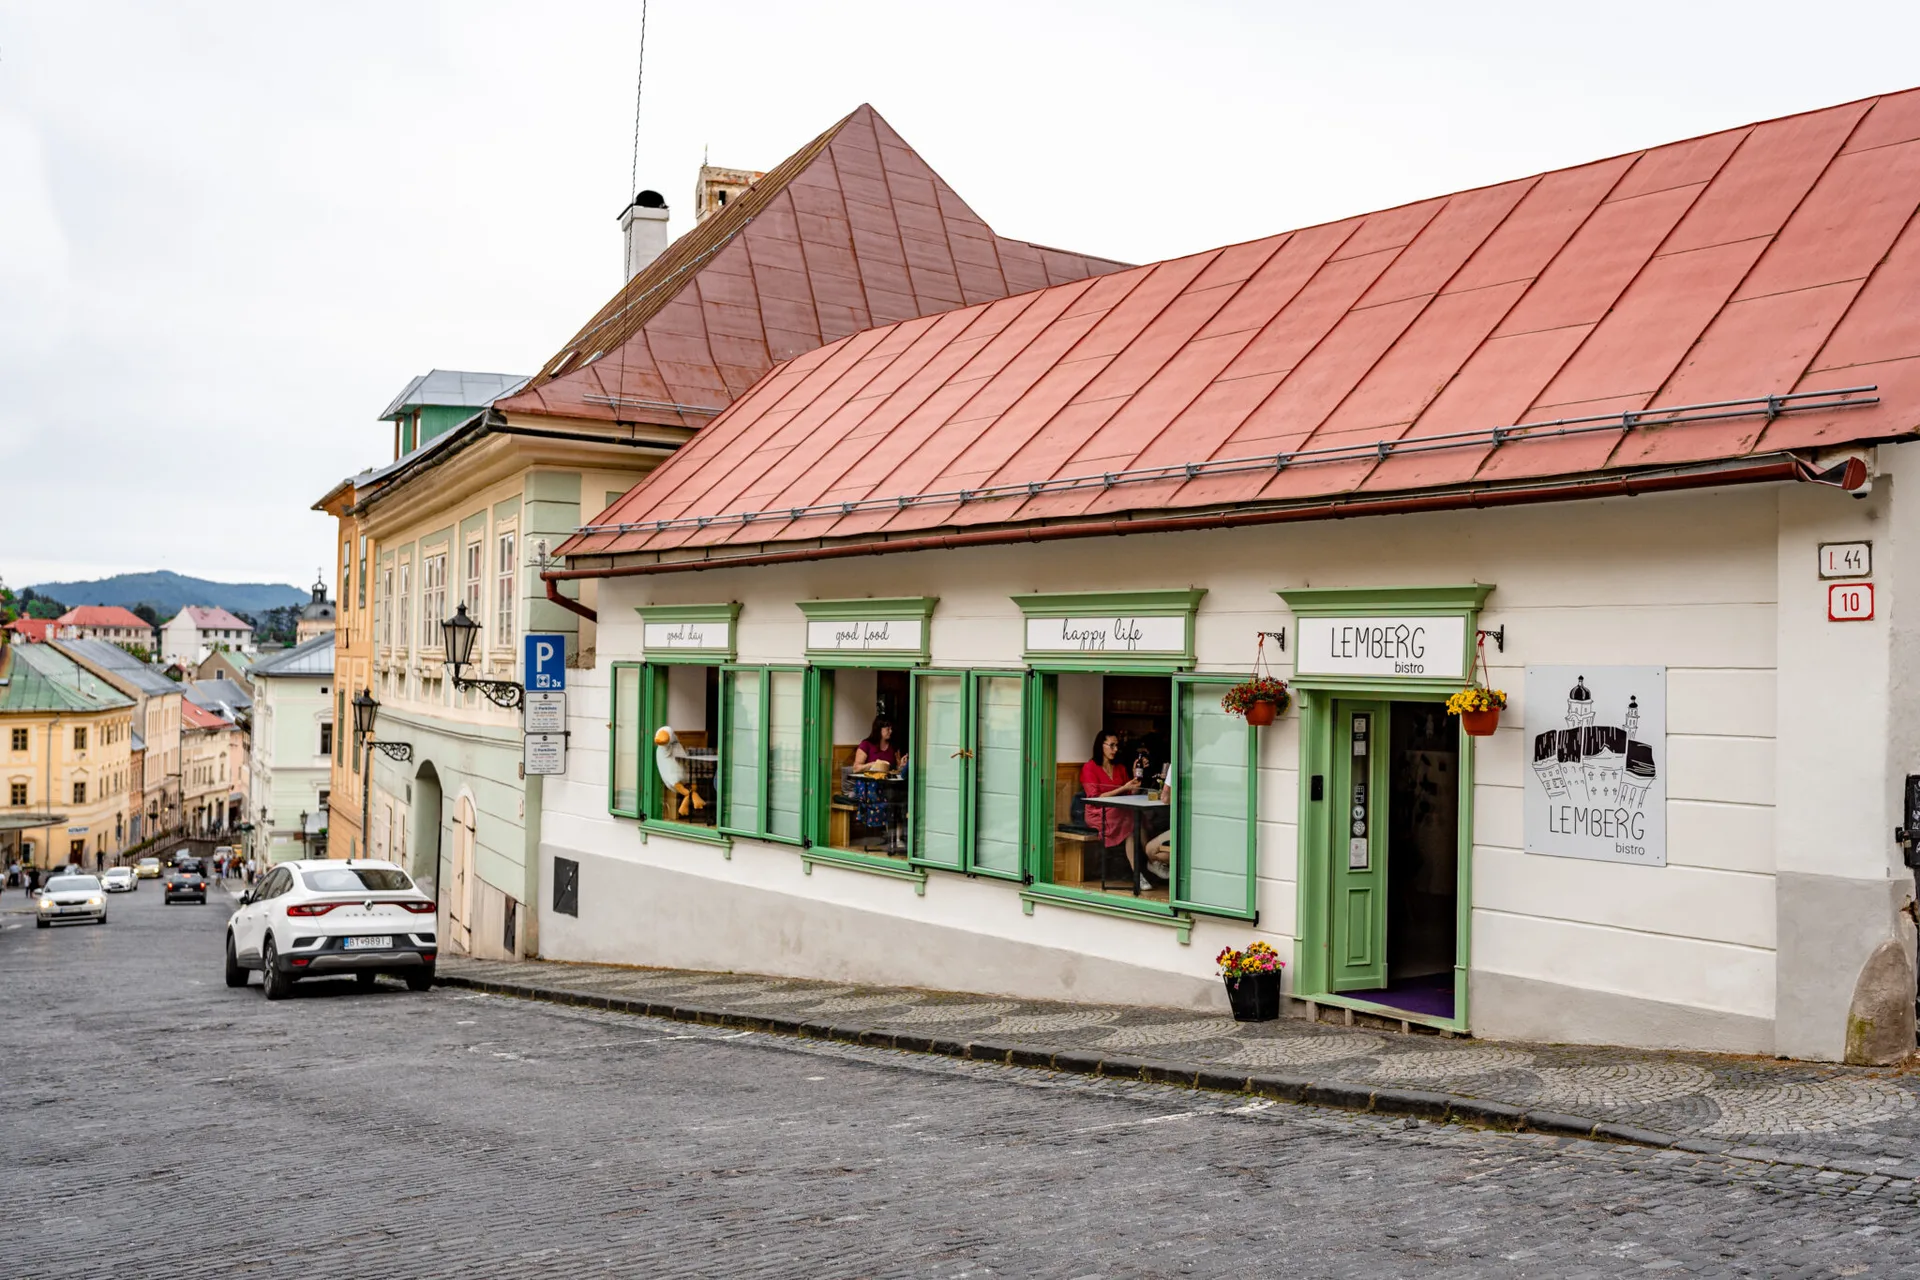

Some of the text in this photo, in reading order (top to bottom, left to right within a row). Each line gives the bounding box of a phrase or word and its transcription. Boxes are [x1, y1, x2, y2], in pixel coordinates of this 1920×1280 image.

[1844, 550, 1861, 569] 44
[1841, 592, 1859, 612] 10
[667, 624, 703, 648] good day
[836, 622, 889, 650] good food
[1062, 618, 1143, 650] happy life
[1331, 624, 1425, 659] LEMBERG
[536, 642, 554, 672] P
[1394, 661, 1424, 674] bistro
[551, 678, 562, 688] 3x
[1549, 805, 1645, 840] LEMBERG
[1615, 842, 1645, 856] bistro
